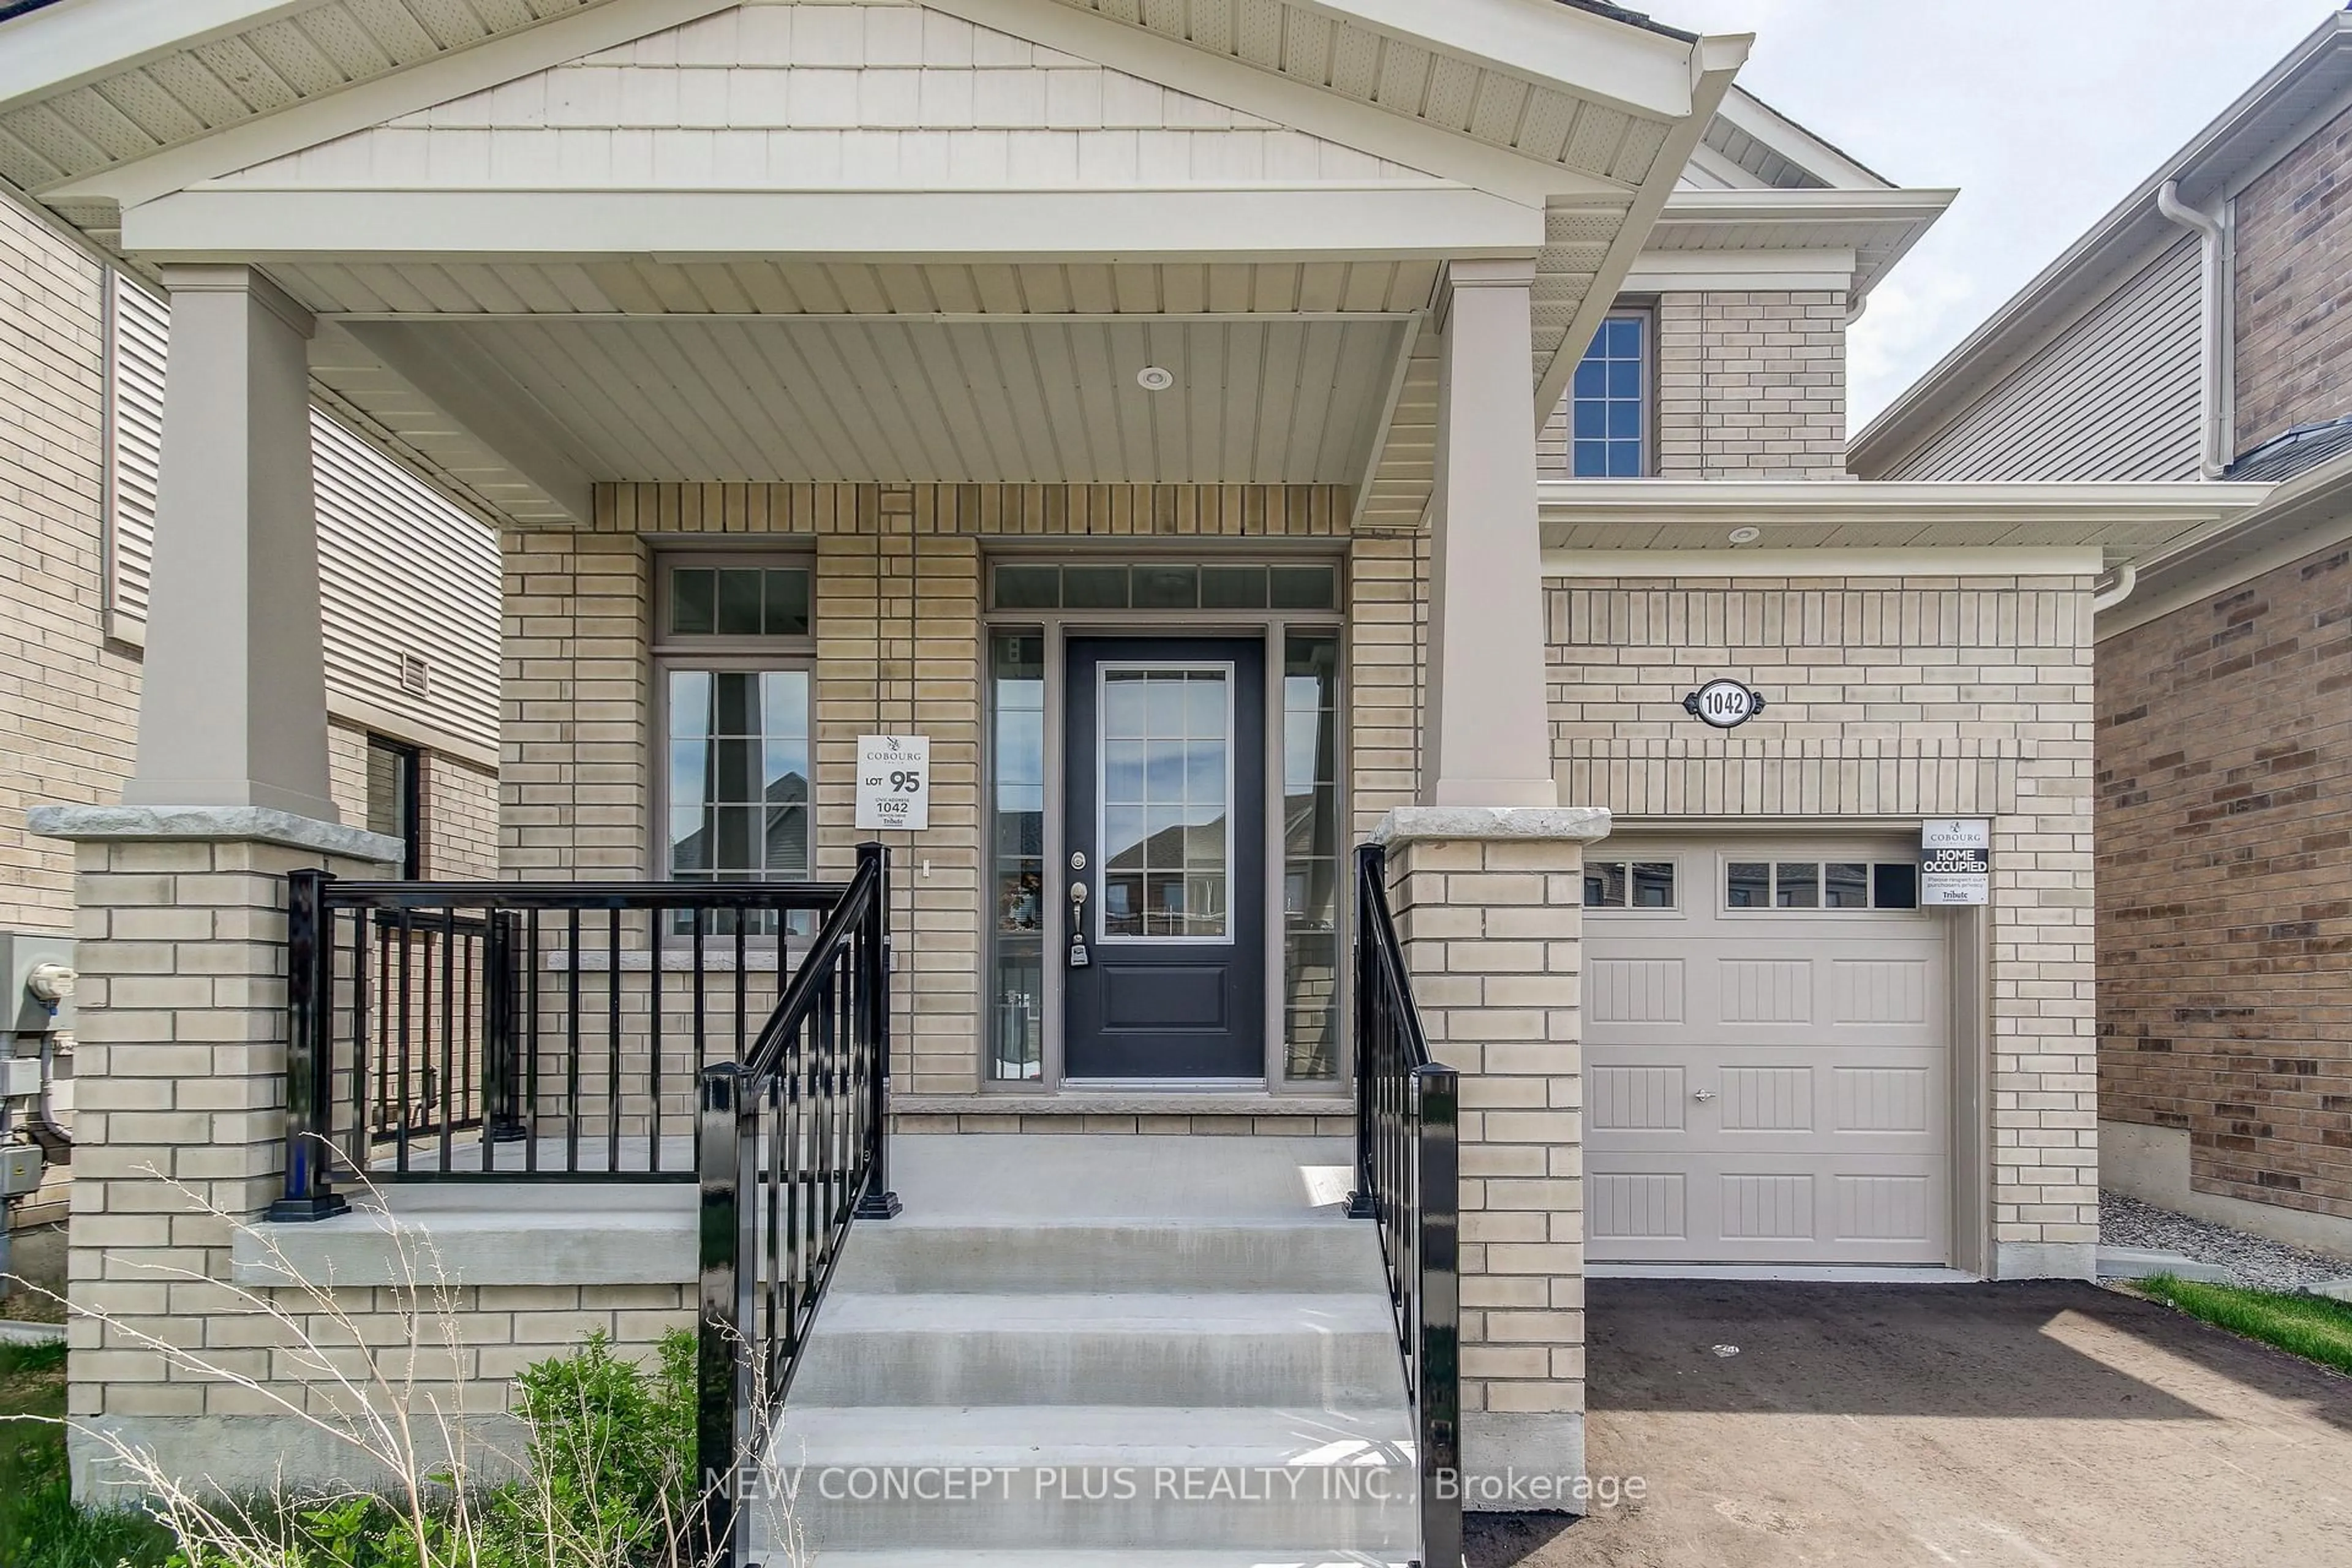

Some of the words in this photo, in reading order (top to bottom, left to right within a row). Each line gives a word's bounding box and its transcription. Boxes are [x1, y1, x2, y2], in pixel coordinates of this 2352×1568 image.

[1706, 693, 1743, 714] 1042
[890, 771, 920, 793] 95
[877, 802, 908, 813] 1042
[1936, 850, 1975, 861] HOME
[1923, 861, 1988, 872] OCCUPIED
